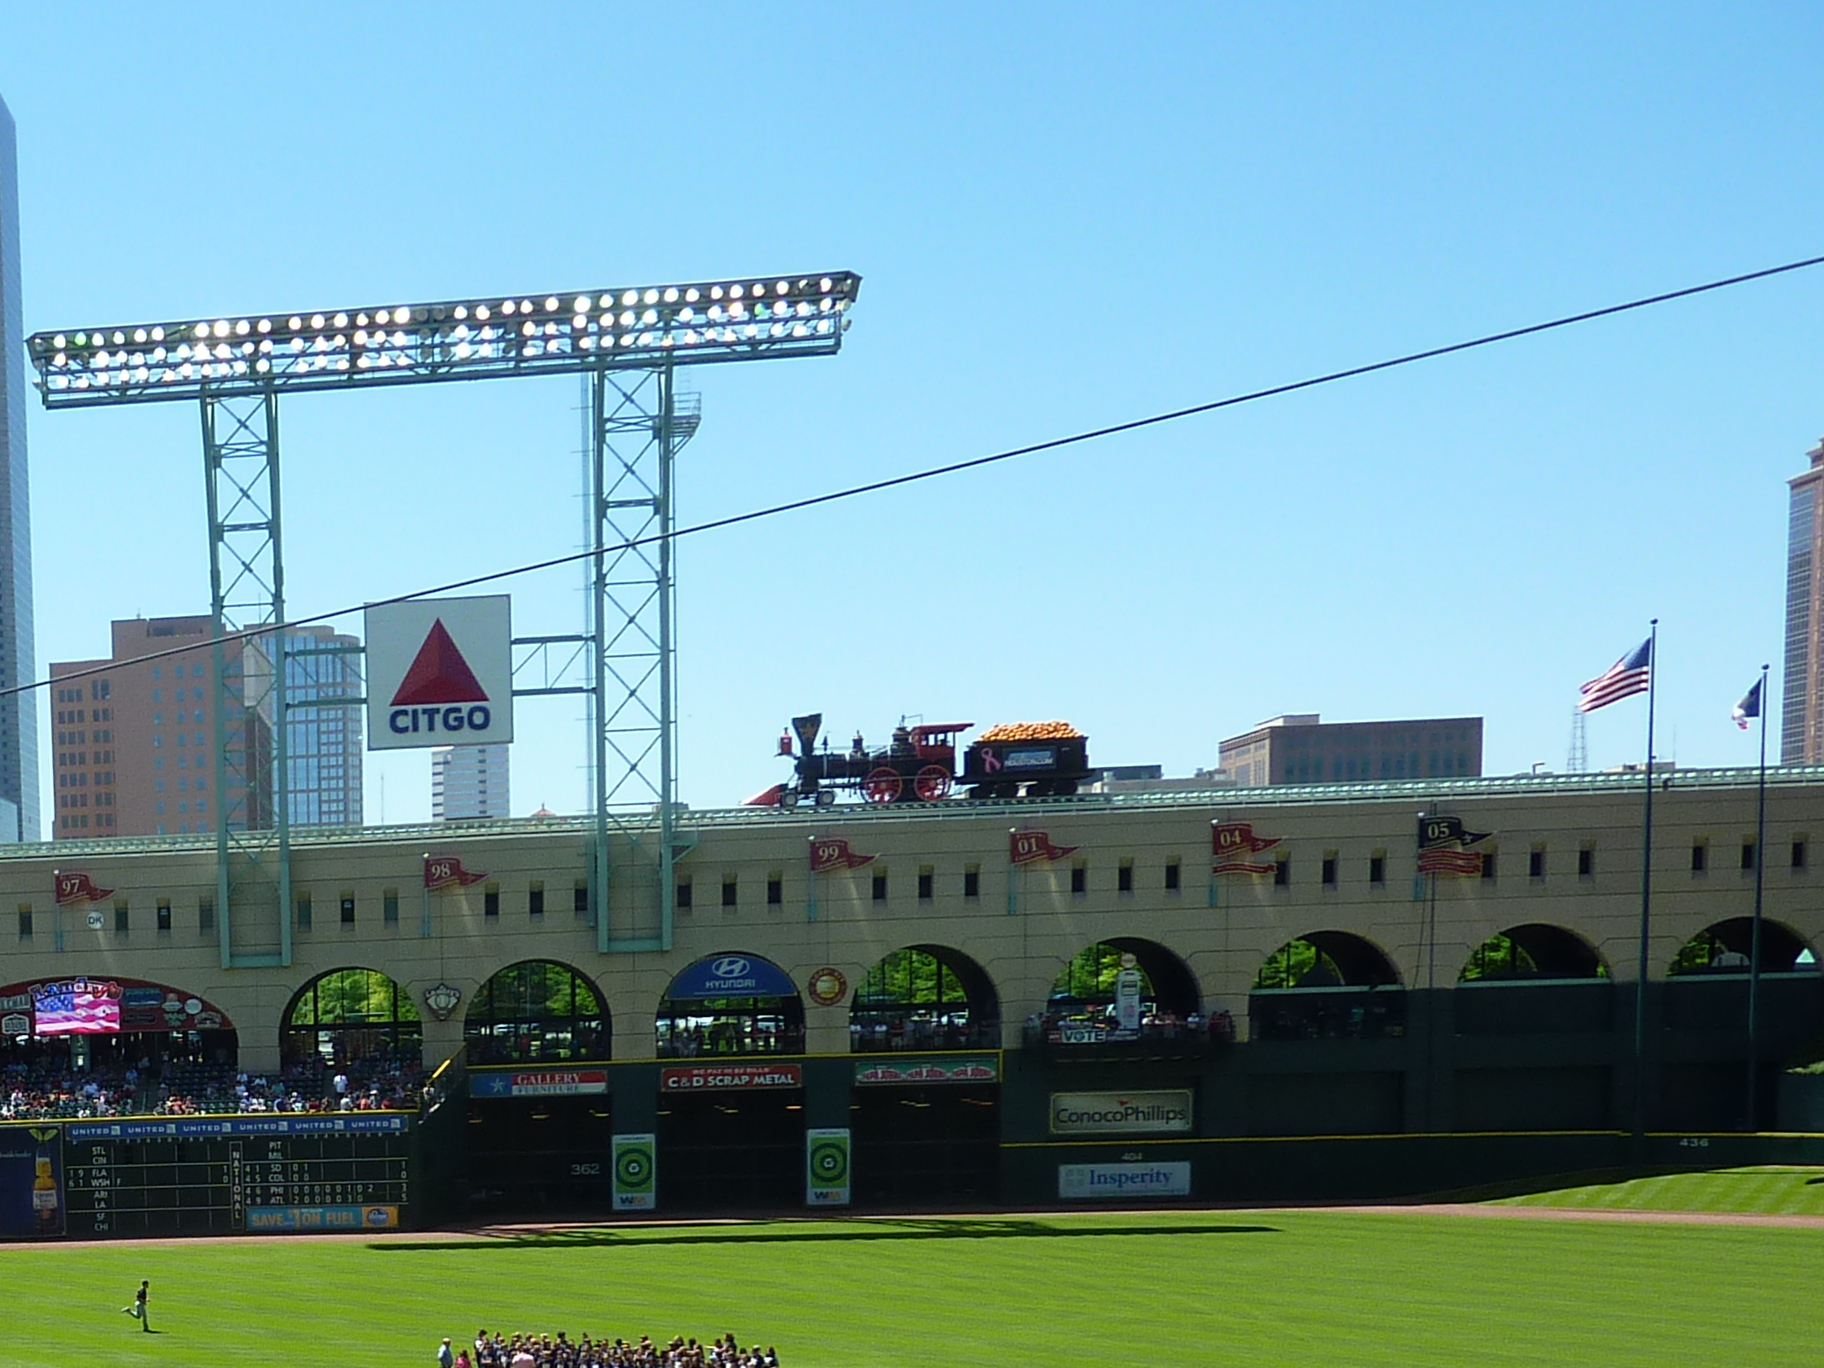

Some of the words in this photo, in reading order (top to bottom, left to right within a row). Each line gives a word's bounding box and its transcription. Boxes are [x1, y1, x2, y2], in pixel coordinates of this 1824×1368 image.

[389, 705, 491, 734] CITGO
[1427, 822, 1450, 840] 05
[1220, 829, 1242, 847] 04
[1018, 837, 1038, 854] 01
[818, 845, 840, 862] 99
[431, 862, 451, 879] 98
[62, 879, 80, 895] 97
[88, 916, 103, 925] DK
[705, 978, 756, 989] HYUNDAI
[1065, 1030, 1105, 1042] VOTE
[517, 1072, 583, 1085] GALLERY
[668, 1077, 679, 1088] C
[680, 1077, 690, 1087] &
[692, 1076, 704, 1086] D
[707, 1075, 750, 1087] SCRAP
[753, 1073, 795, 1085] METAL
[517, 1085, 580, 1095] FURNITURE
[1056, 1105, 1187, 1125] ConocoPhillips
[127, 1125, 165, 1134] UNITED
[183, 1123, 221, 1133] UNITED
[239, 1122, 277, 1131] UNITED
[295, 1121, 333, 1130] UNITED
[351, 1120, 389, 1129] UNITED
[72, 1126, 110, 1136] UNITED
[269, 1141, 283, 1150] PIT
[1679, 1137, 1709, 1148] 436
[92, 1146, 107, 1156] STL
[268, 1151, 283, 1160] MIL
[92, 1156, 107, 1165] CIN
[1121, 1152, 1143, 1161] 404
[92, 1168, 107, 1177] FLA
[270, 1163, 282, 1172] SD
[571, 1163, 600, 1176] 362
[91, 1178, 111, 1188] WSH
[268, 1174, 285, 1183] COL
[1089, 1168, 1173, 1189] Insperity
[233, 1151, 242, 1219] NATIONAL
[270, 1185, 284, 1195] PHI
[94, 1190, 109, 1199] ARI
[269, 1195, 285, 1204] ATL
[94, 1201, 106, 1209] LA
[96, 1212, 106, 1222] SF
[252, 1212, 284, 1227] SAVE
[302, 1212, 321, 1226] ON
[326, 1211, 356, 1225] FUEL
[94, 1222, 109, 1231] CHI
